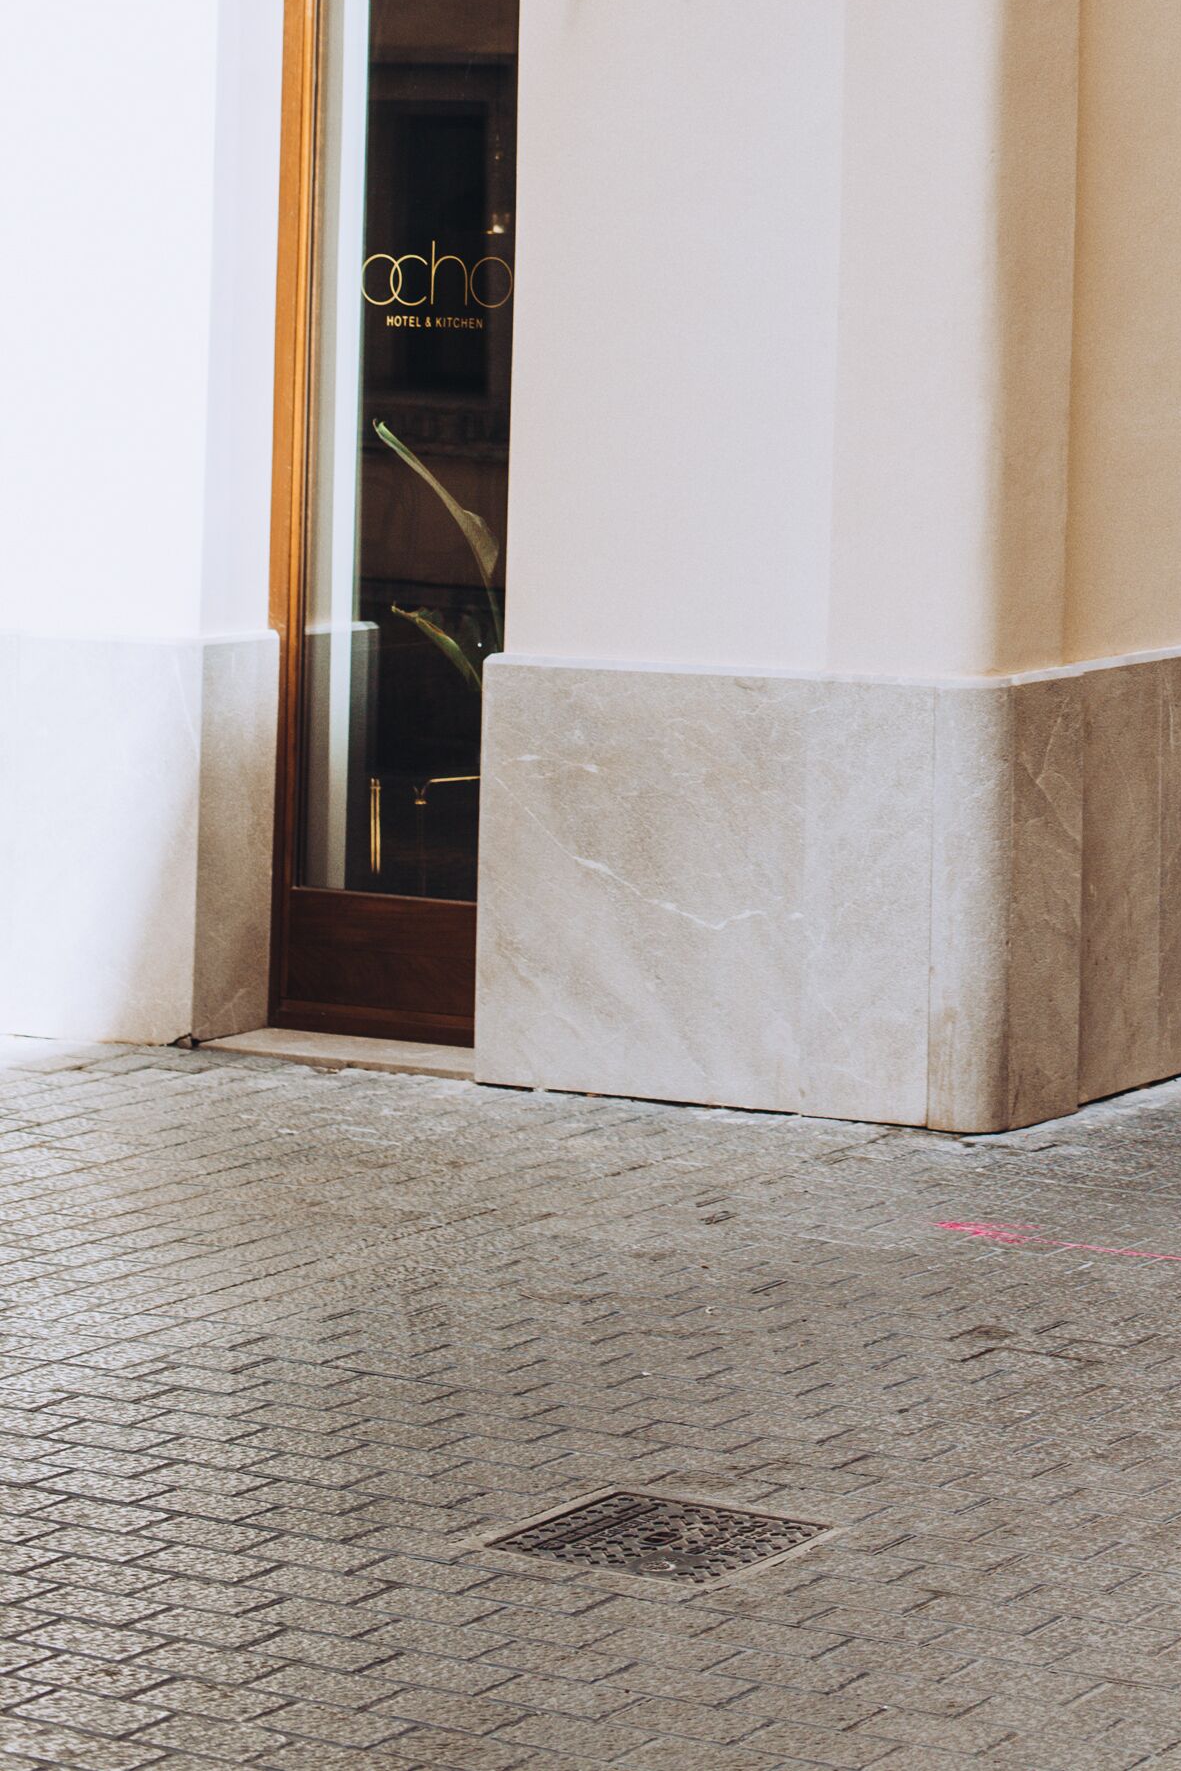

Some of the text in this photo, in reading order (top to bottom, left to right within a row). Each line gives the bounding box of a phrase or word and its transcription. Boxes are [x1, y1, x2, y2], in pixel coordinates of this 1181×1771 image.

[386, 315, 484, 329] HOTEL & KITCHEN
